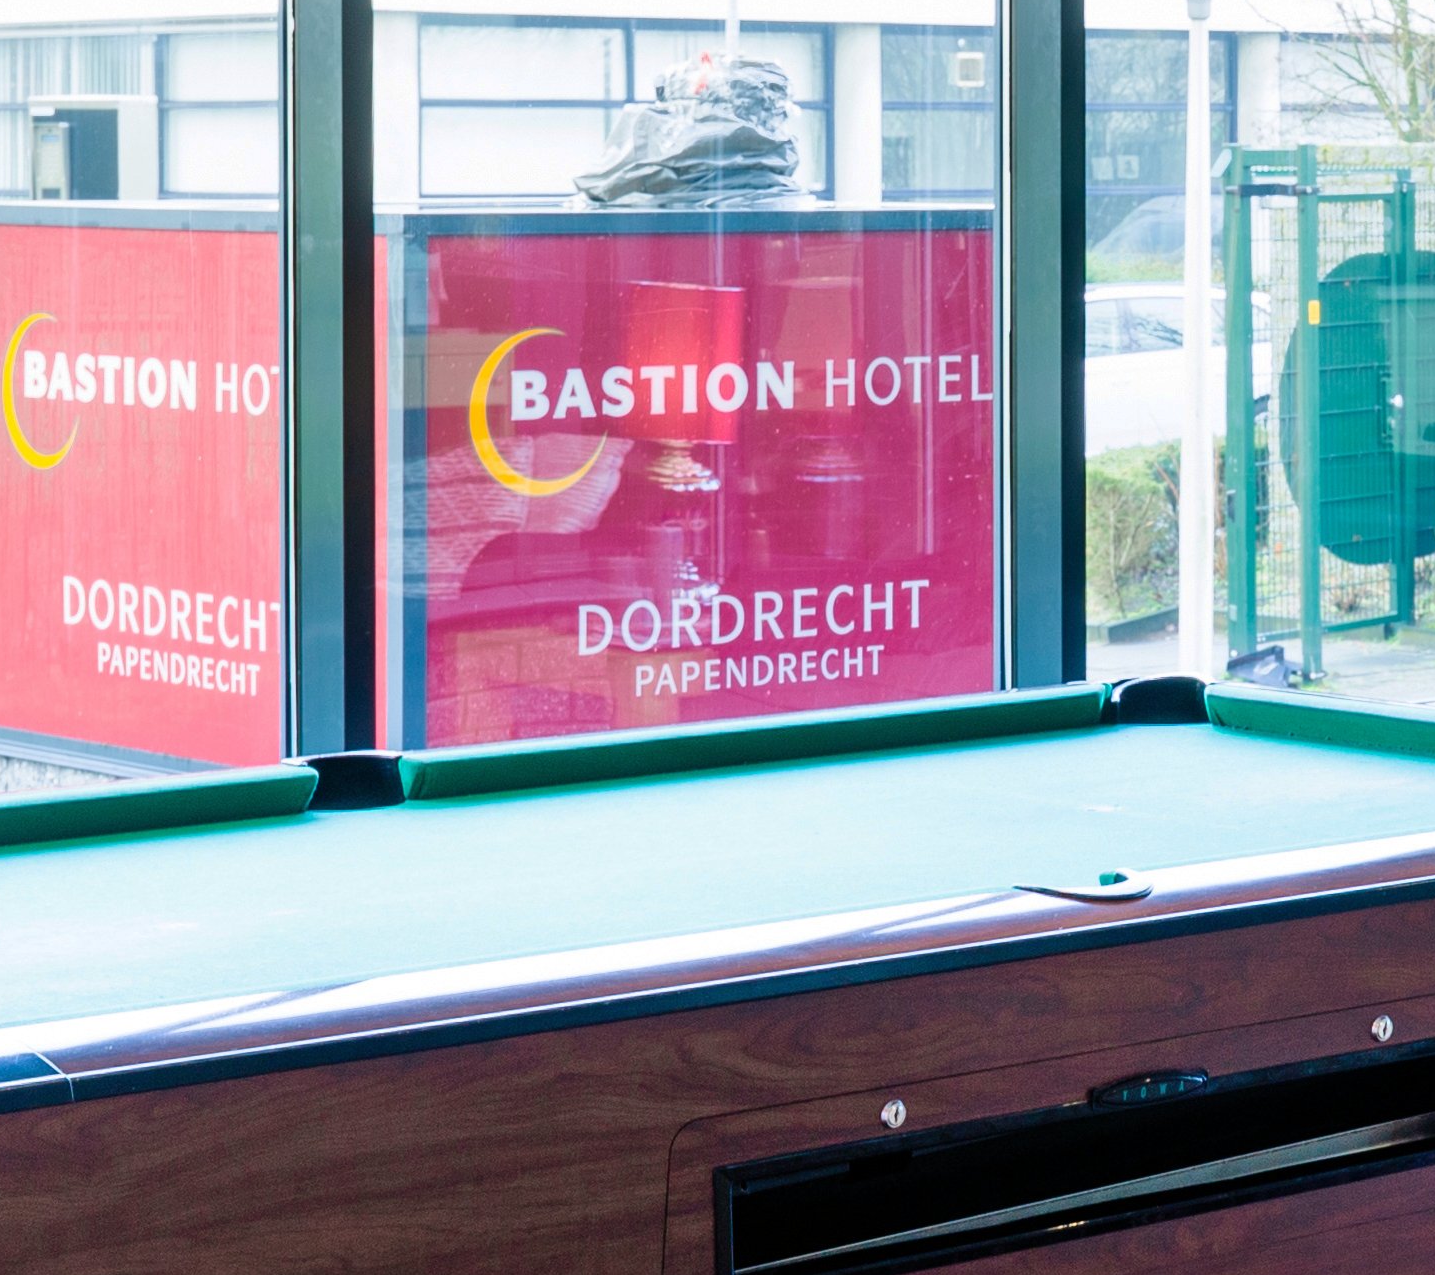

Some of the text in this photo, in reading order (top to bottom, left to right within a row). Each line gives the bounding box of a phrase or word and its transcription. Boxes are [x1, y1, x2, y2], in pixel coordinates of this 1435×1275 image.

[22, 349, 198, 412] BASTION
[510, 354, 994, 422] BASTION HOTEL
[578, 579, 930, 656] DORDRECHT
[97, 642, 261, 697] PAPENDRECHT
[635, 644, 886, 697] PAPENDRECHT
